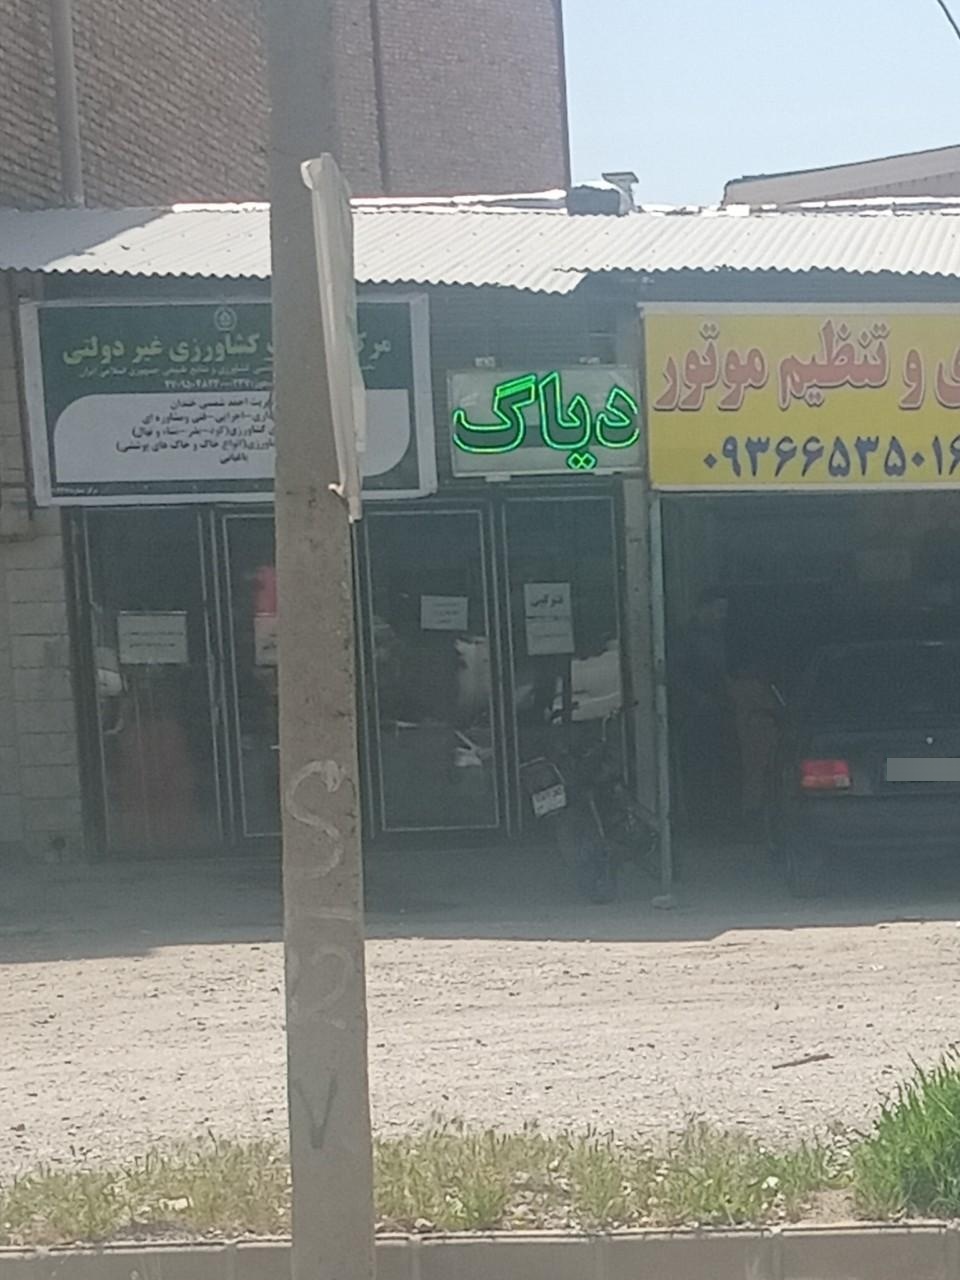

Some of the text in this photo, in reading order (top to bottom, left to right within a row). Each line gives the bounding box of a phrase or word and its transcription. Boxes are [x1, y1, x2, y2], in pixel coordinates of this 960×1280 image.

[63, 336, 124, 365] دولتی
[132, 336, 164, 363] غیر
[168, 332, 260, 363] کشاورزی
[654, 322, 768, 411] موتور
[779, 318, 890, 410] تنظیم
[900, 347, 926, 409] و
[453, 372, 640, 469] دیاگ
